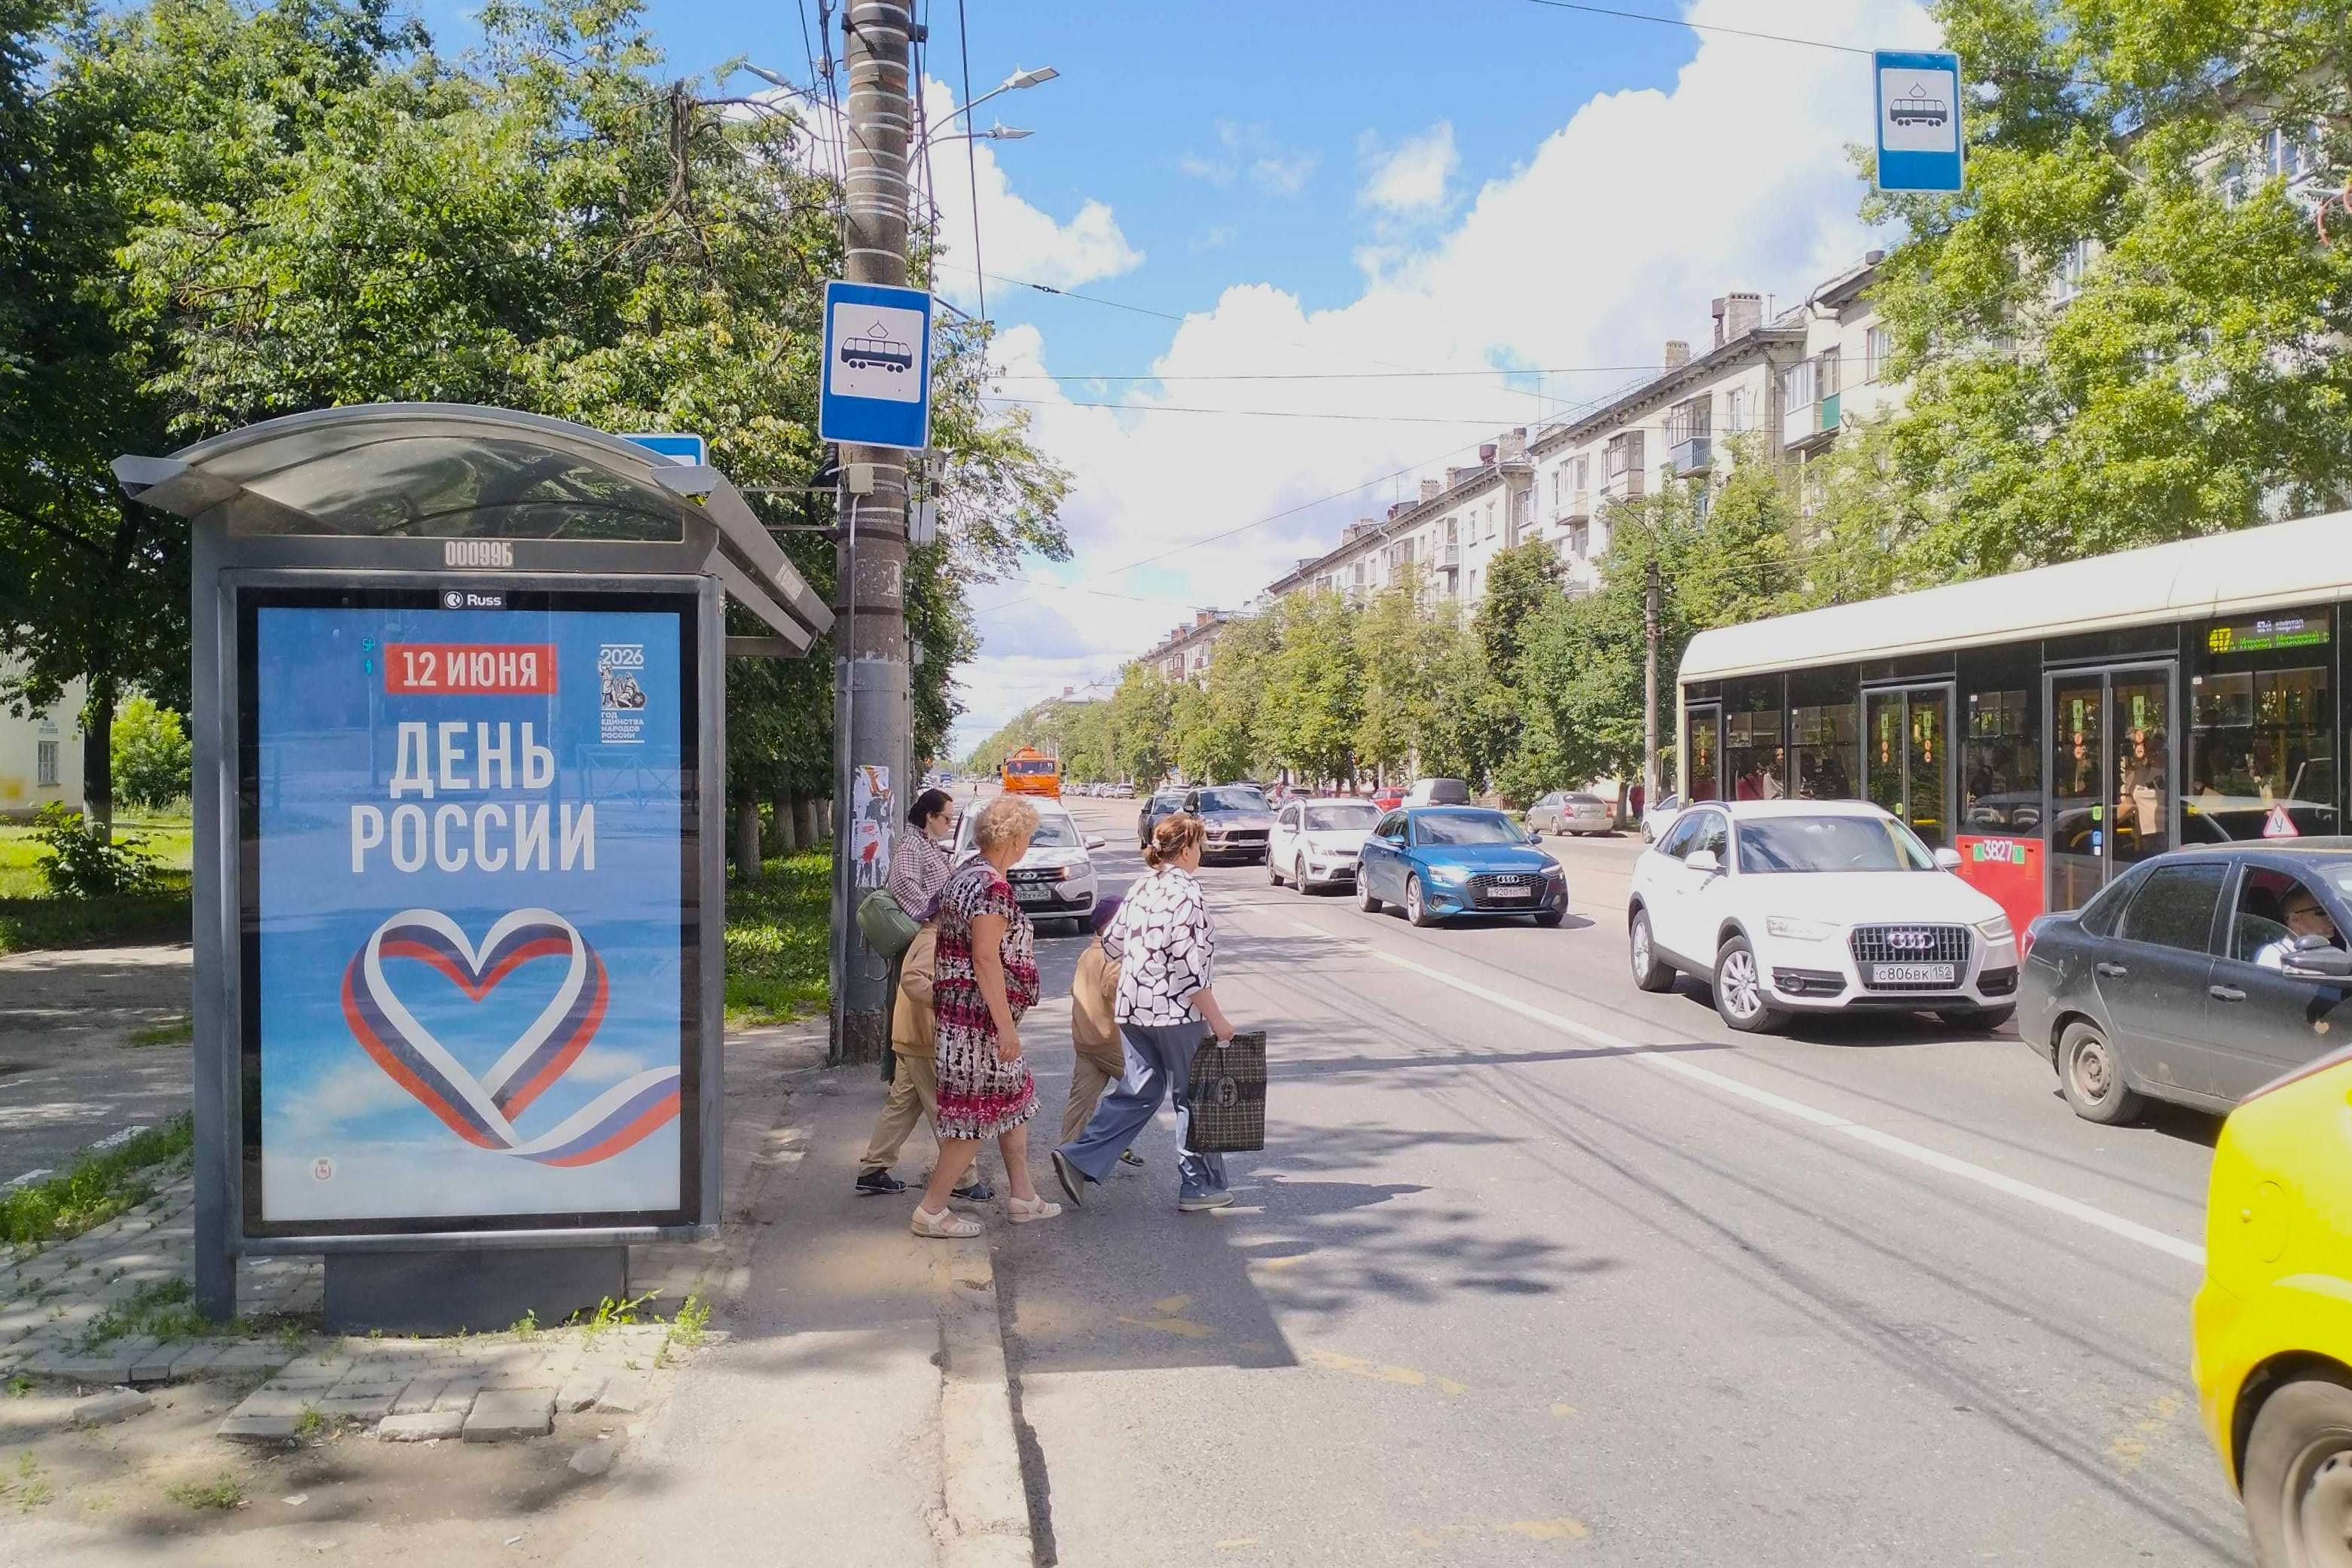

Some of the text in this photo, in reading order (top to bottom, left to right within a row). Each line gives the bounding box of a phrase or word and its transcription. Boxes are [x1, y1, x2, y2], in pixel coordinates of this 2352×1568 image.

[467, 593, 502, 606] Russ
[601, 648, 645, 665] 2026
[402, 651, 538, 687] 12 ИЮНЯ
[389, 721, 555, 799] ДЕНЬ
[350, 804, 596, 873] РОССИИ
[1984, 839, 2013, 862] 3827
[1932, 966, 1951, 978] 152
